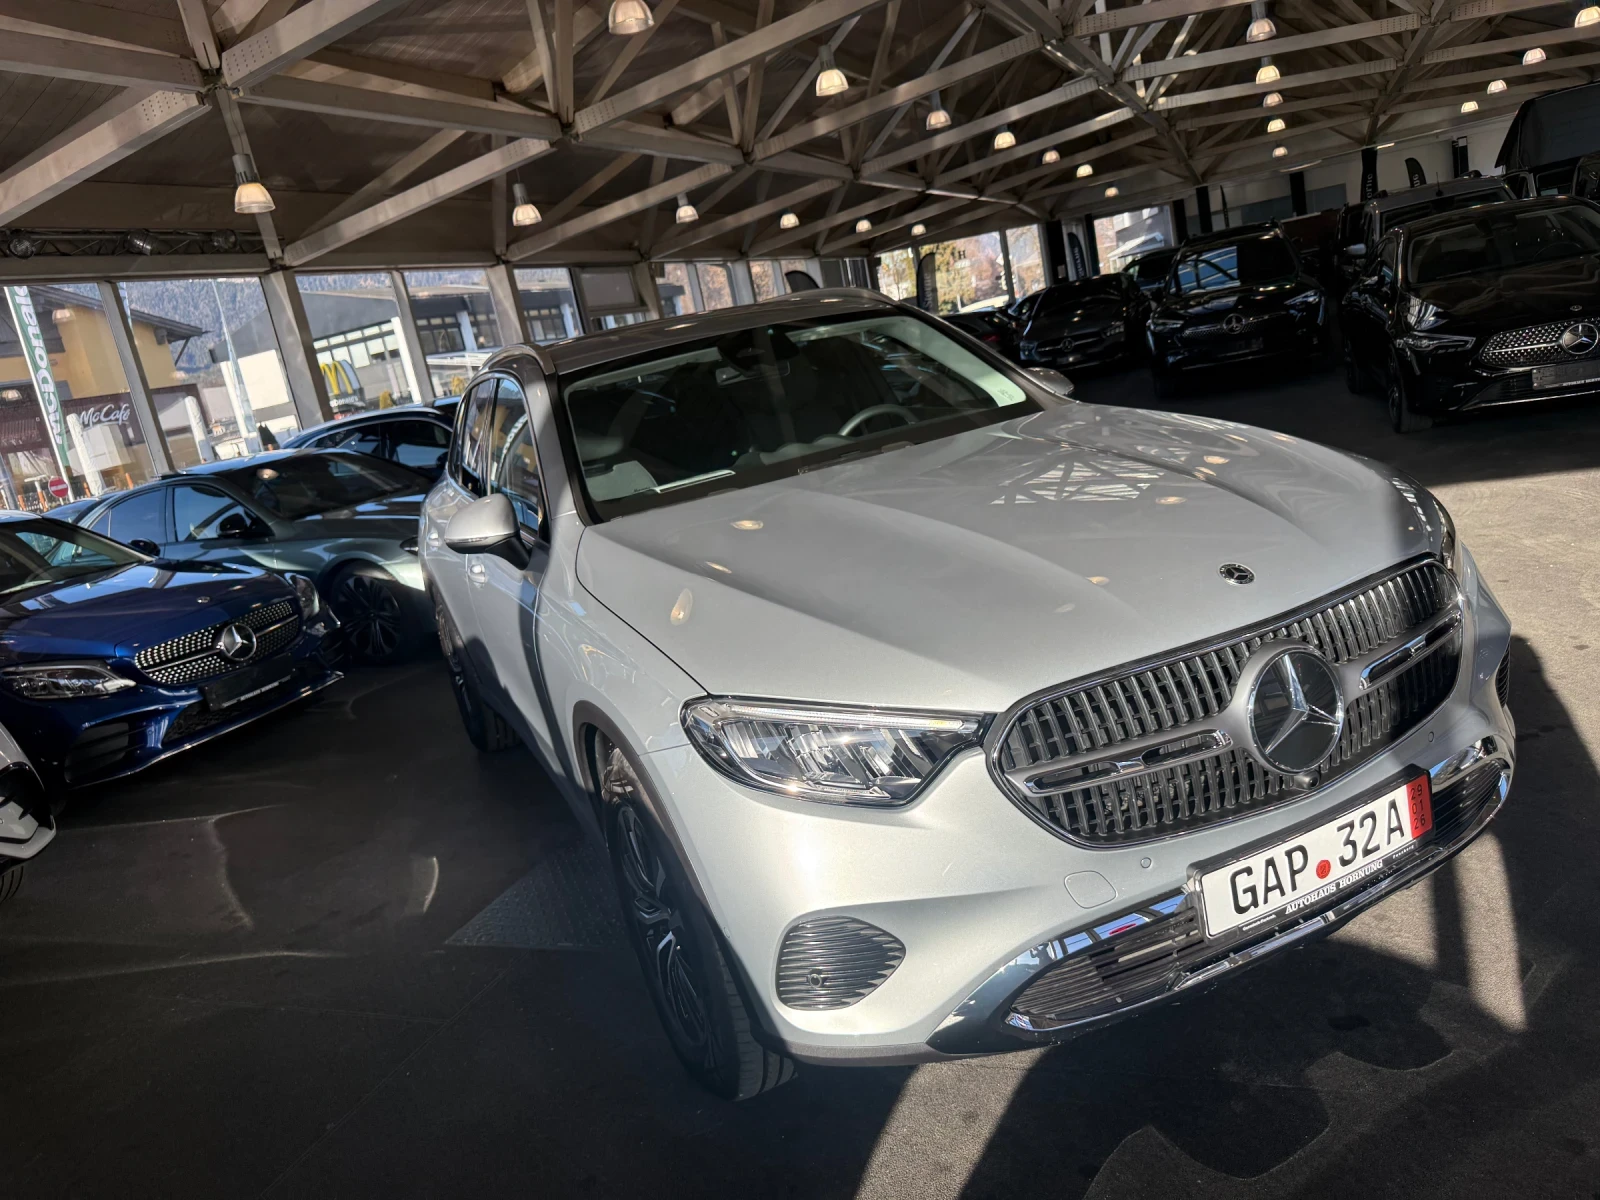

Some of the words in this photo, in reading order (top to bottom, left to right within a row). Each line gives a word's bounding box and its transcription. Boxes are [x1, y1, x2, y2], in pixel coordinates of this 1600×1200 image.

[1411, 784, 1423, 800] 29
[1411, 799, 1424, 815] 01
[1413, 814, 1426, 831] 26
[1230, 844, 1309, 915] GAP
[1285, 885, 1337, 915] AUTOHAUS
[1339, 859, 1384, 890] HORNUNG
